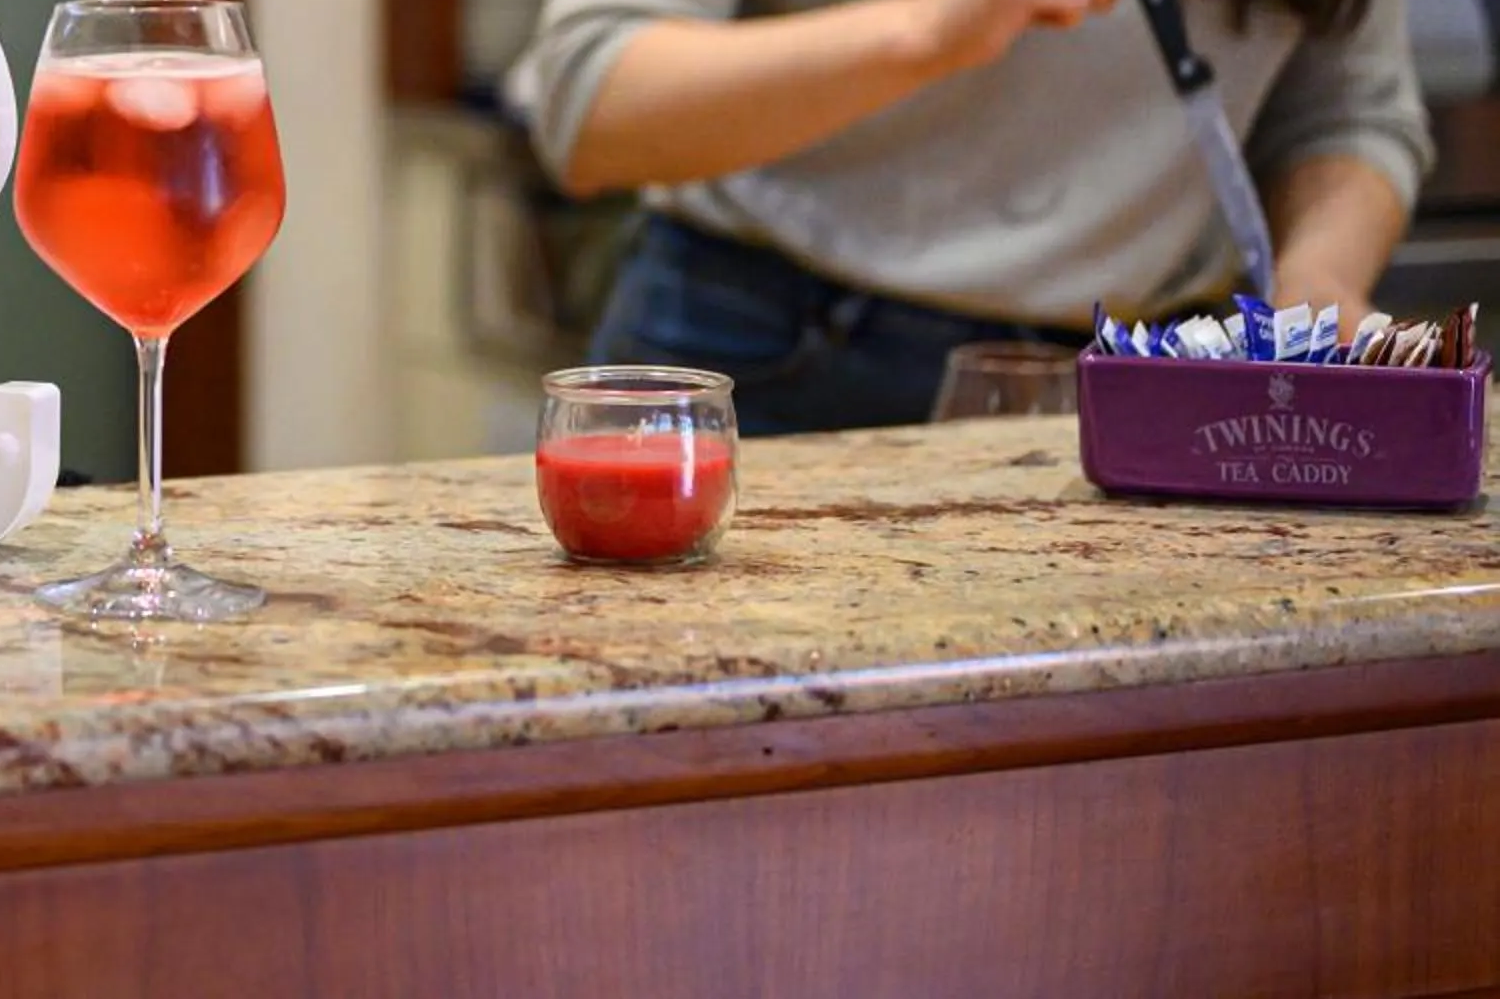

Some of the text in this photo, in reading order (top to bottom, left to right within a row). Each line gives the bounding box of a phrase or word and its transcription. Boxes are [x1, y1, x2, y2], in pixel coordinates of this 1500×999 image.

[1194, 413, 1376, 458] TWININGS
[1217, 461, 1353, 485] TEA CADDY
